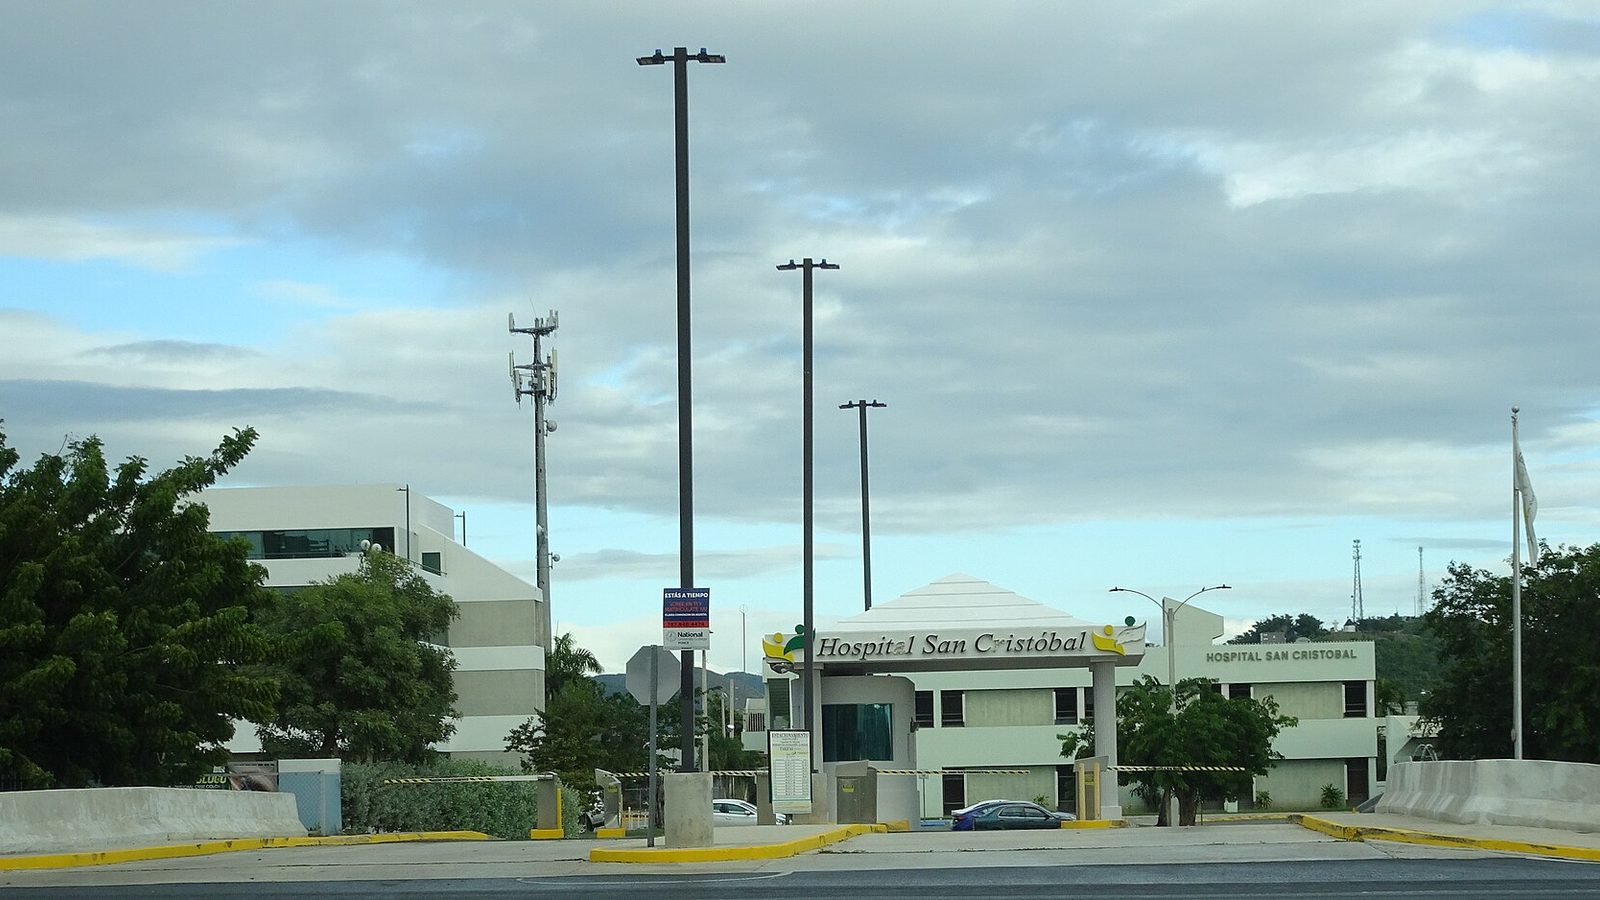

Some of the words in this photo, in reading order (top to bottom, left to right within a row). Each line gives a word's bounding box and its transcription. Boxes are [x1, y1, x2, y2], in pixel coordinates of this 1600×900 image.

[817, 636, 914, 660] Hospital
[922, 634, 967, 655] San
[974, 630, 1087, 653] Cristóbal
[1206, 651, 1262, 662] HOSPITAL
[1266, 650, 1289, 660] SAN
[1292, 649, 1358, 660] CRISTOBAL
